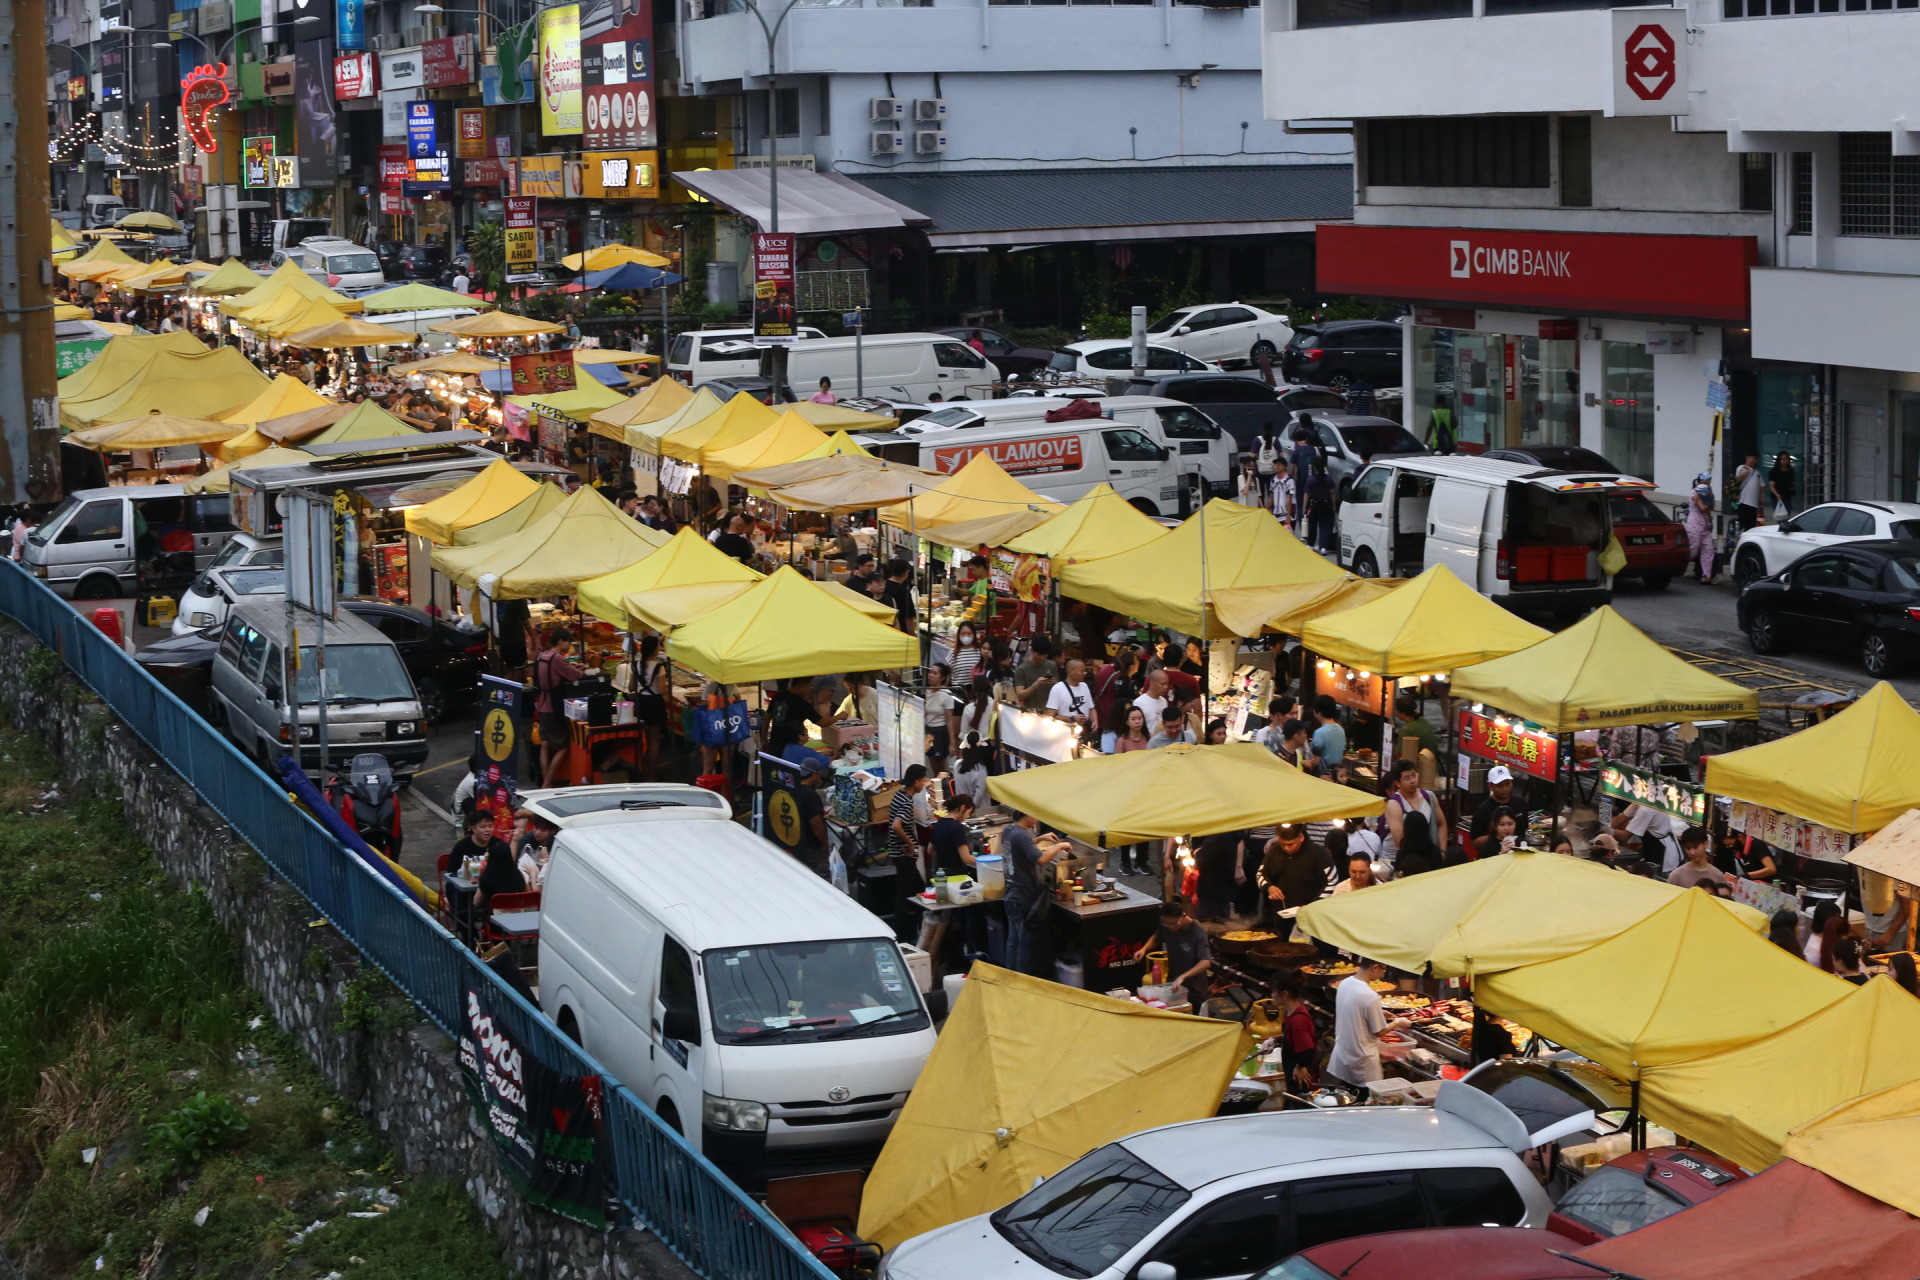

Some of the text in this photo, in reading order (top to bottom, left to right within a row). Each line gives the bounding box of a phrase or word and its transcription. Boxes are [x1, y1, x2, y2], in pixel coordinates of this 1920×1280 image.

[409, 118, 434, 126] FARMASI
[602, 159, 628, 187] MBF
[508, 219, 533, 227] TERBUKA
[508, 231, 534, 242] SABTU
[766, 239, 788, 248] UCSI
[511, 249, 532, 260] AHAD
[758, 254, 789, 262] TAWARAN
[759, 262, 790, 270] BIASISWA
[1473, 247, 1571, 278] CIMB BANK
[757, 286, 776, 295] 100%
[1600, 703, 1744, 719] PASAR MALAM KUALA LUMPUR
[491, 714, 506, 754] 串
[1750, 808, 1794, 841] 水果茶
